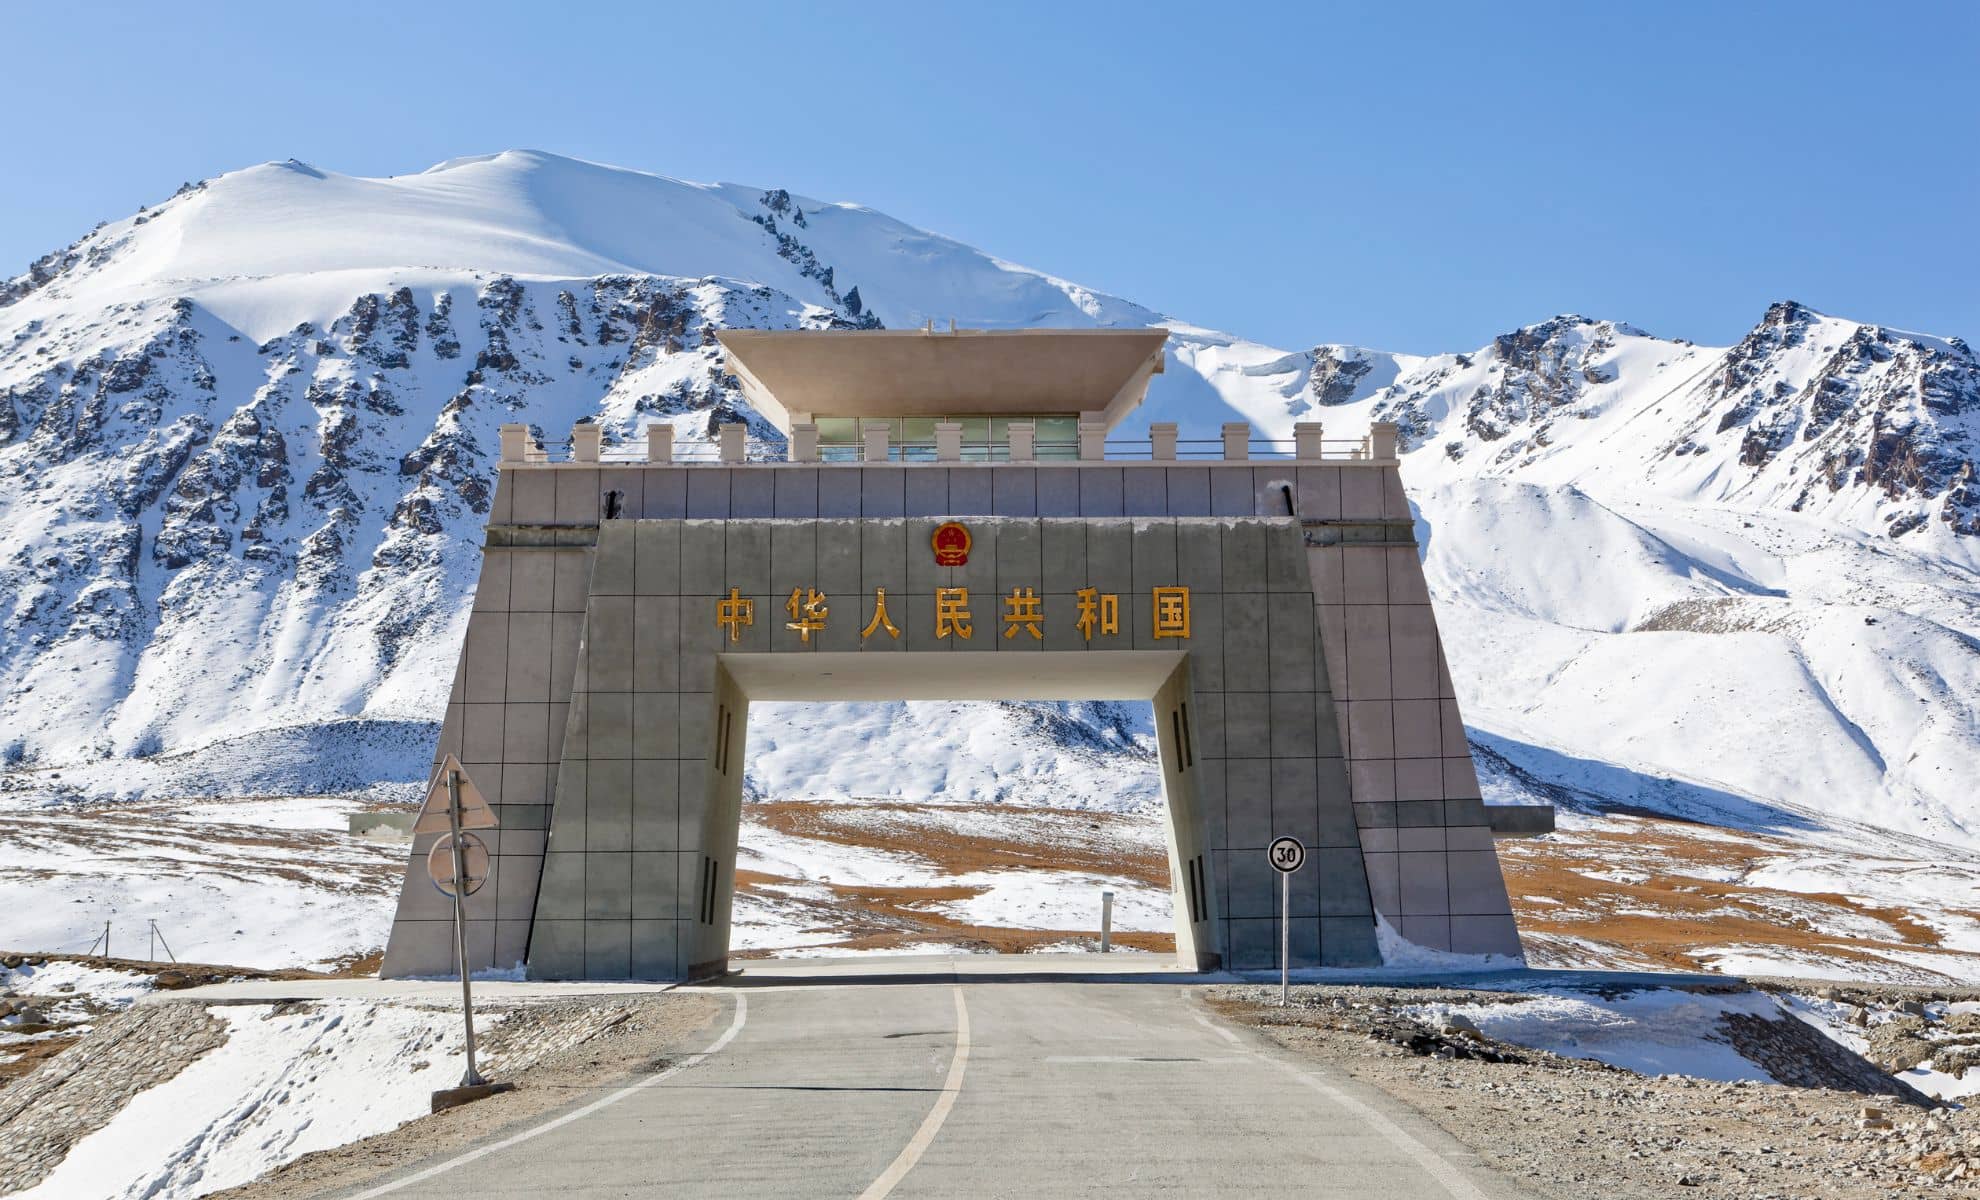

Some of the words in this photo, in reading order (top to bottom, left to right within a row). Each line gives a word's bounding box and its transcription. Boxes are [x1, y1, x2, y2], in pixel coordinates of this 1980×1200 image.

[716, 586, 1191, 642] 中华人民共和国
[1277, 847, 1296, 863] 30
